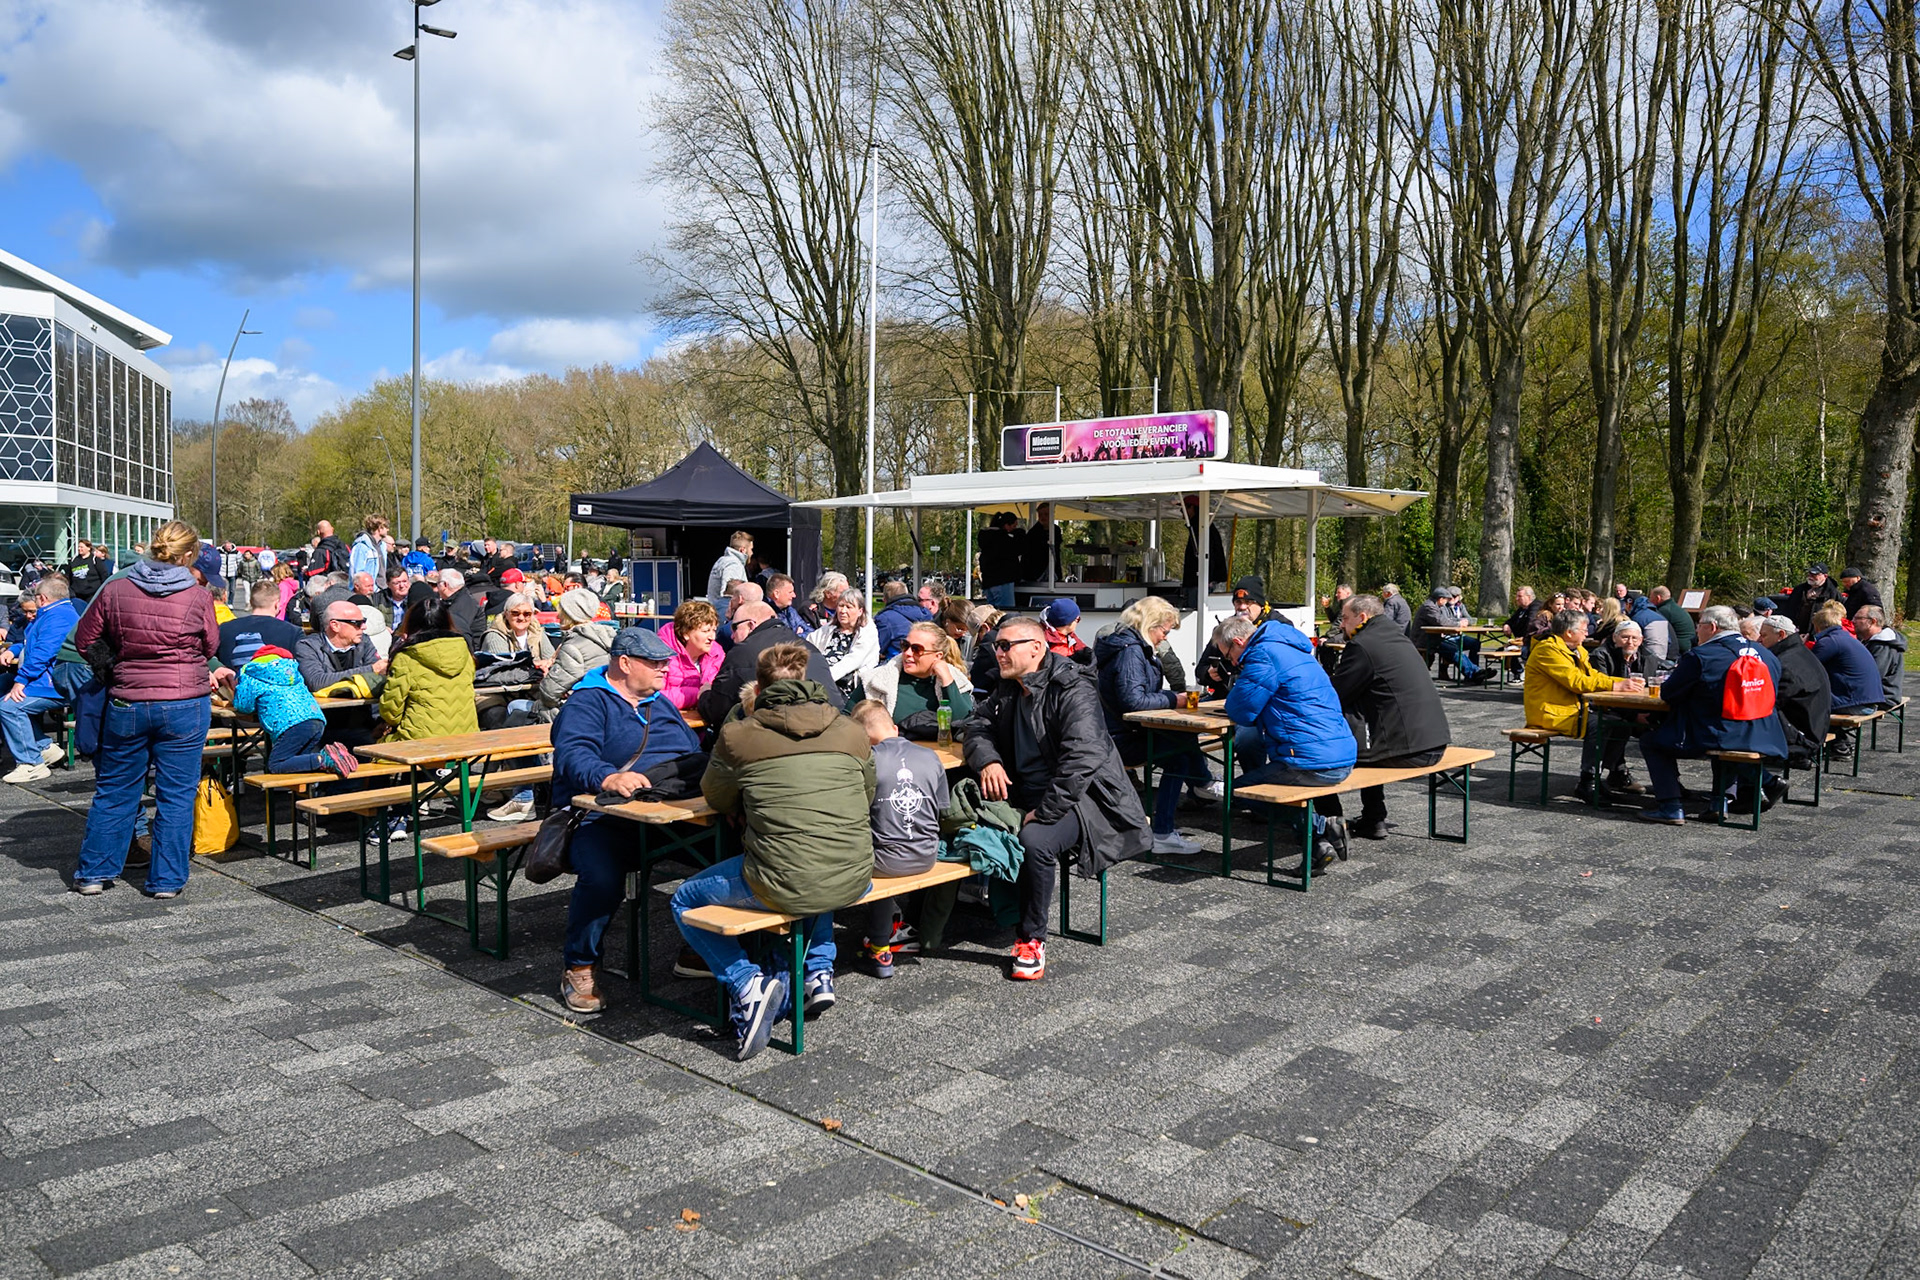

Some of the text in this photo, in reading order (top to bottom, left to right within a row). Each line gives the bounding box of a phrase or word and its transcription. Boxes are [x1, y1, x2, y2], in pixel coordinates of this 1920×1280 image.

[1094, 424, 1188, 438] DE TOTAALLEVERANCIER
[1032, 436, 1060, 446] Miedema
[1103, 435, 1179, 449] VOOR IEDER EVENT!
[1742, 678, 1764, 687] Amica
